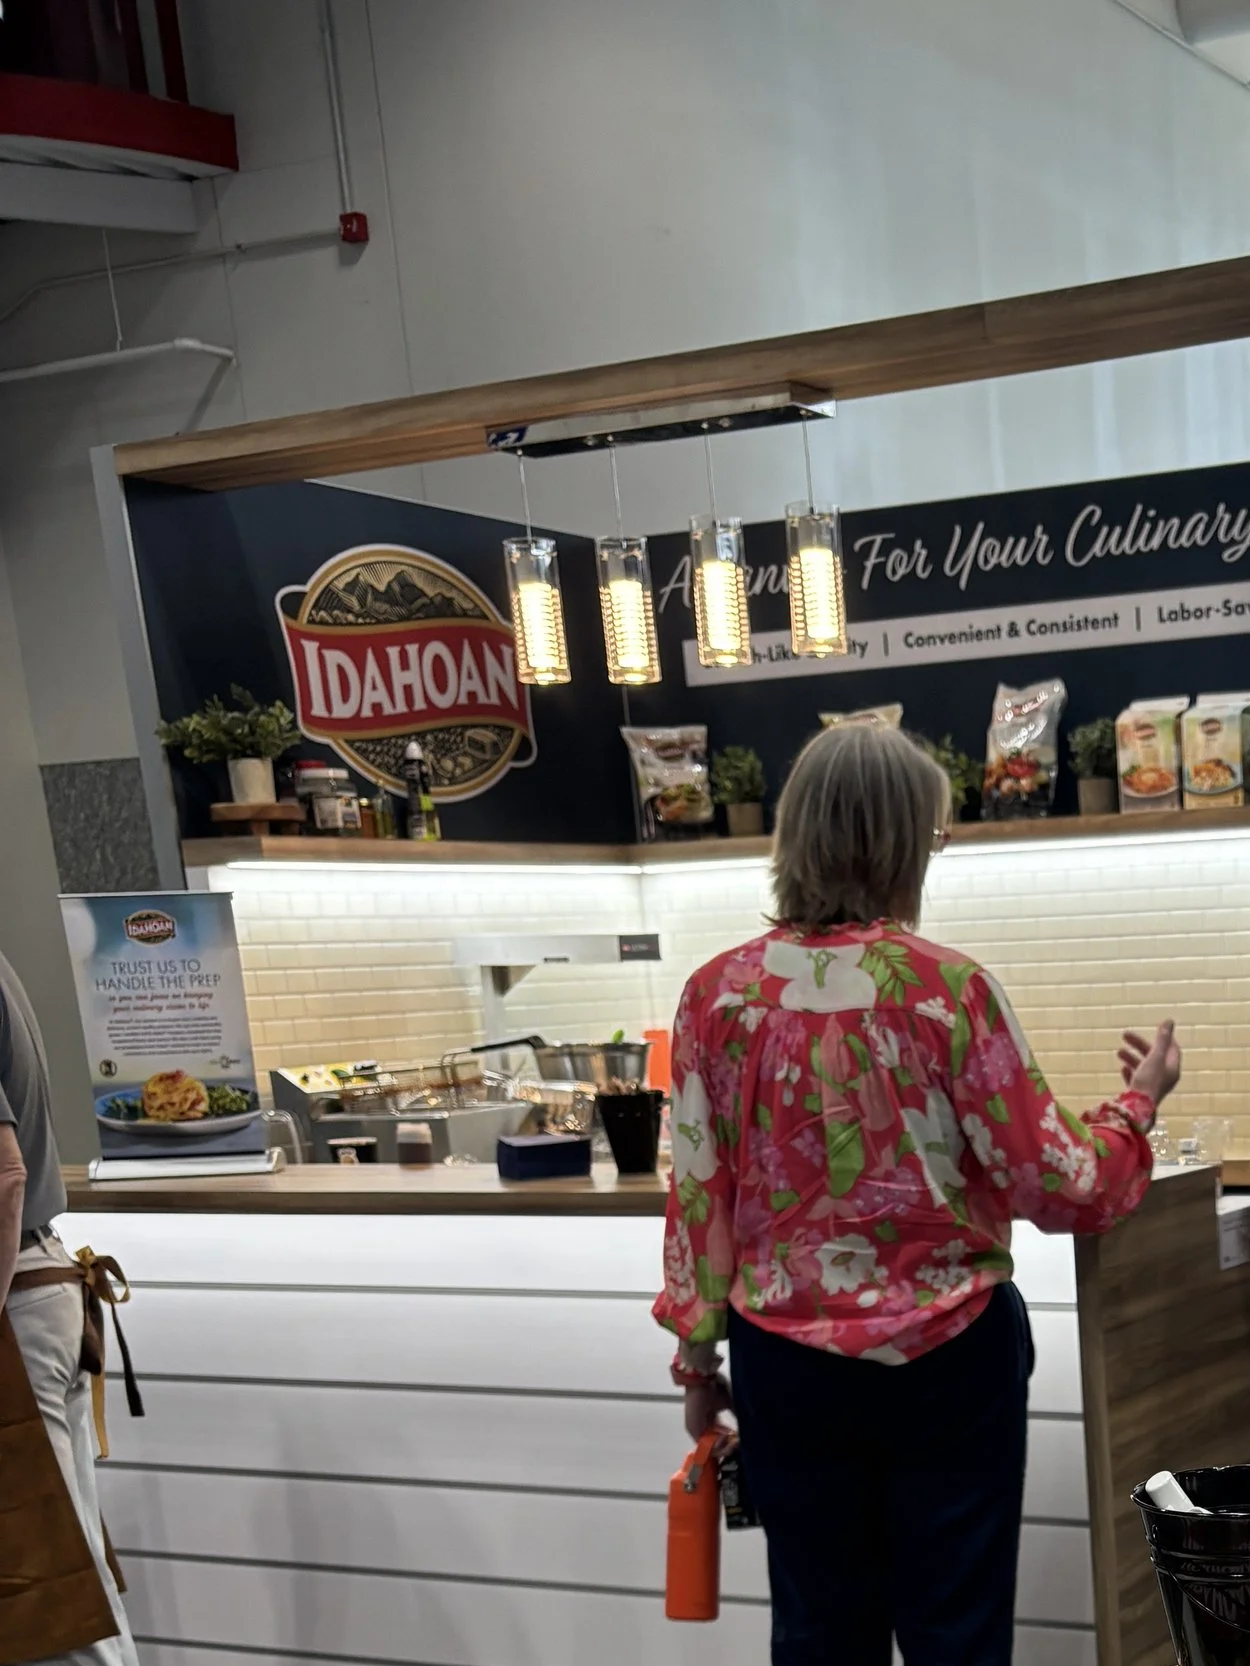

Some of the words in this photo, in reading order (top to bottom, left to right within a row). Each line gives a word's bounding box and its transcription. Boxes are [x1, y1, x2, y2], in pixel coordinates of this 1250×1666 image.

[854, 533, 933, 590] For
[944, 521, 1054, 591] Your
[904, 626, 1001, 648] Convenient
[1007, 621, 1021, 638] &
[1026, 613, 1119, 637] Consistent
[300, 638, 519, 719] IDAHOAN
[95, 976, 156, 991] HANDLE
[158, 975, 184, 989] THE
[190, 973, 220, 988] PREP
[111, 960, 153, 975] TRUST
[157, 960, 177, 973] US
[182, 958, 200, 972] TO
